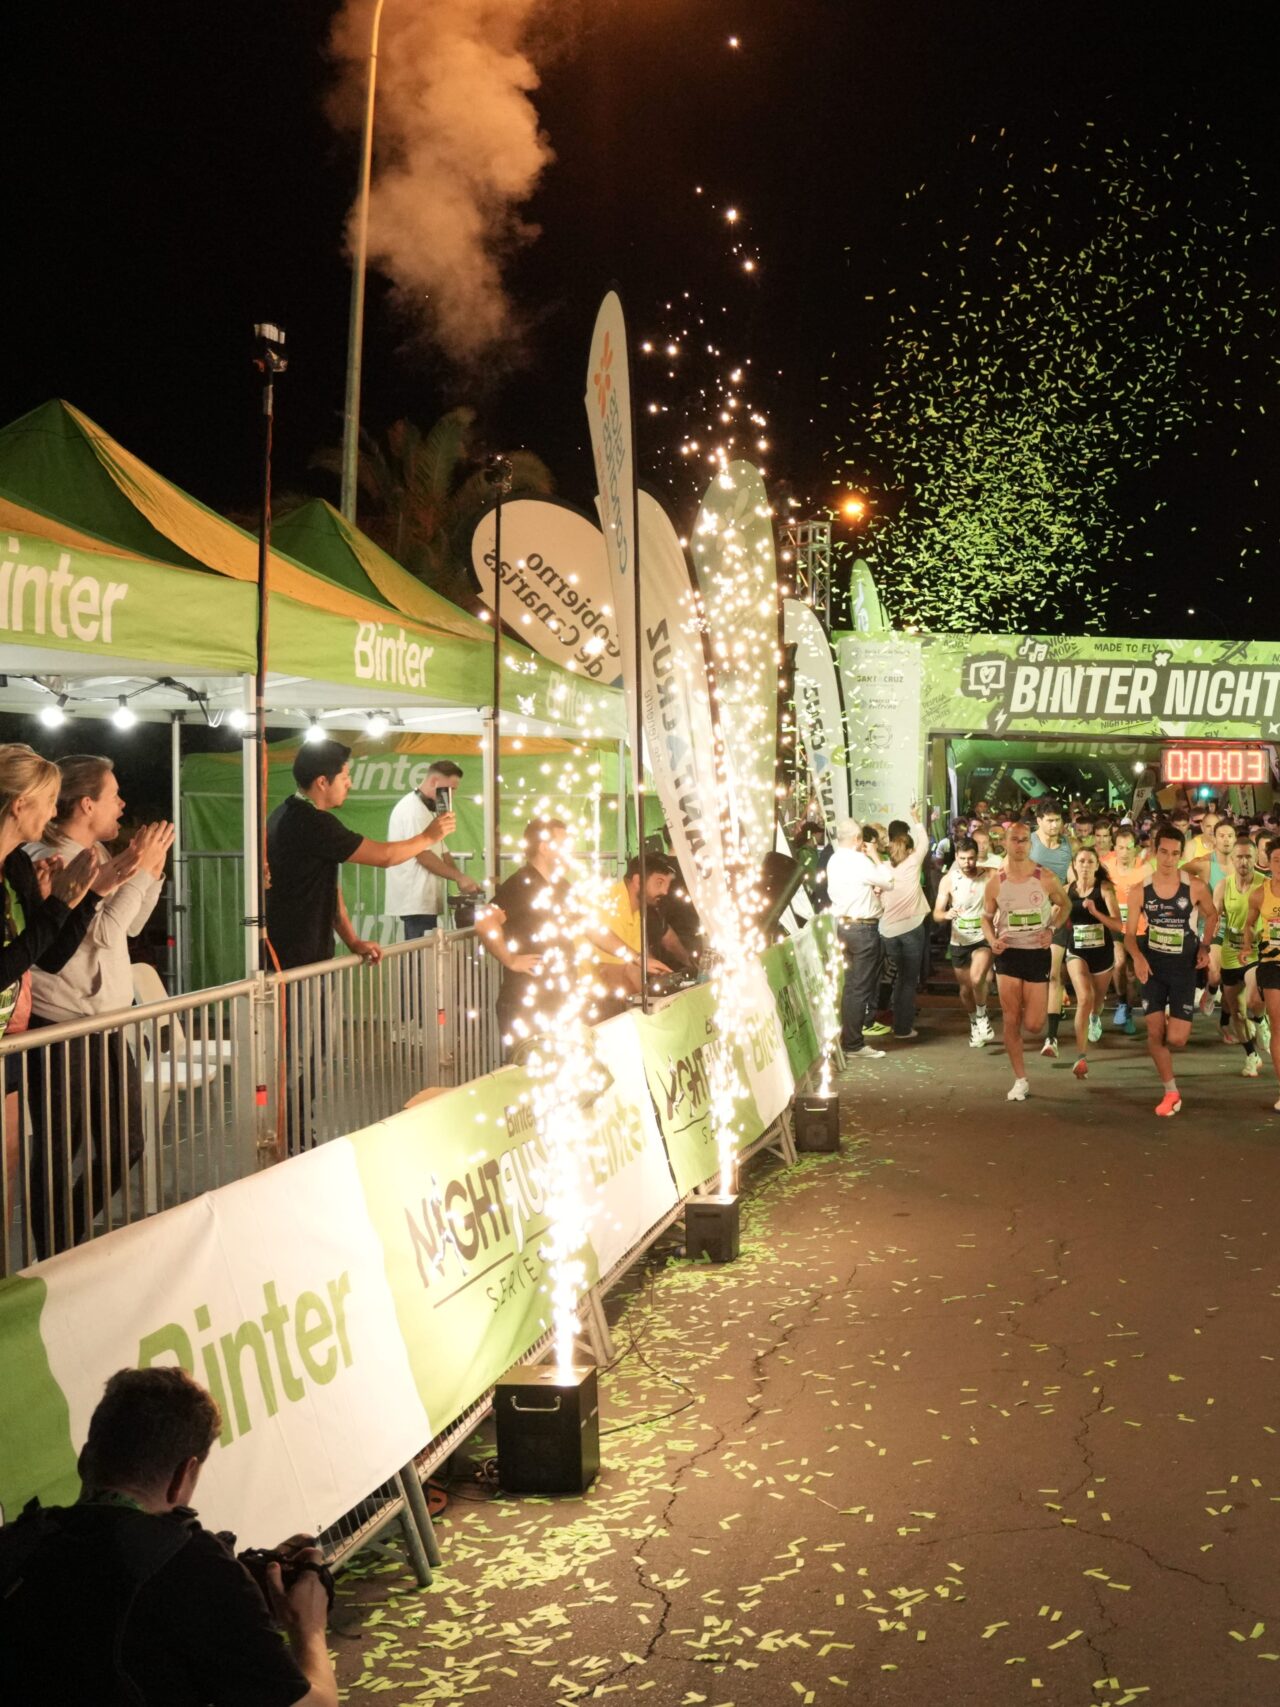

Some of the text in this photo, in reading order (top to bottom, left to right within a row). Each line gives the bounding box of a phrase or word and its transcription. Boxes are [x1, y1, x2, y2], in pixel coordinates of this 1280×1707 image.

[354, 621, 434, 688] Binter
[1094, 643, 1159, 653] MADE TO FLY
[1010, 665, 1157, 714] BINTER
[349, 755, 459, 792] inte
[1167, 750, 1262, 781] 0:00:03
[504, 1103, 537, 1138] Binte
